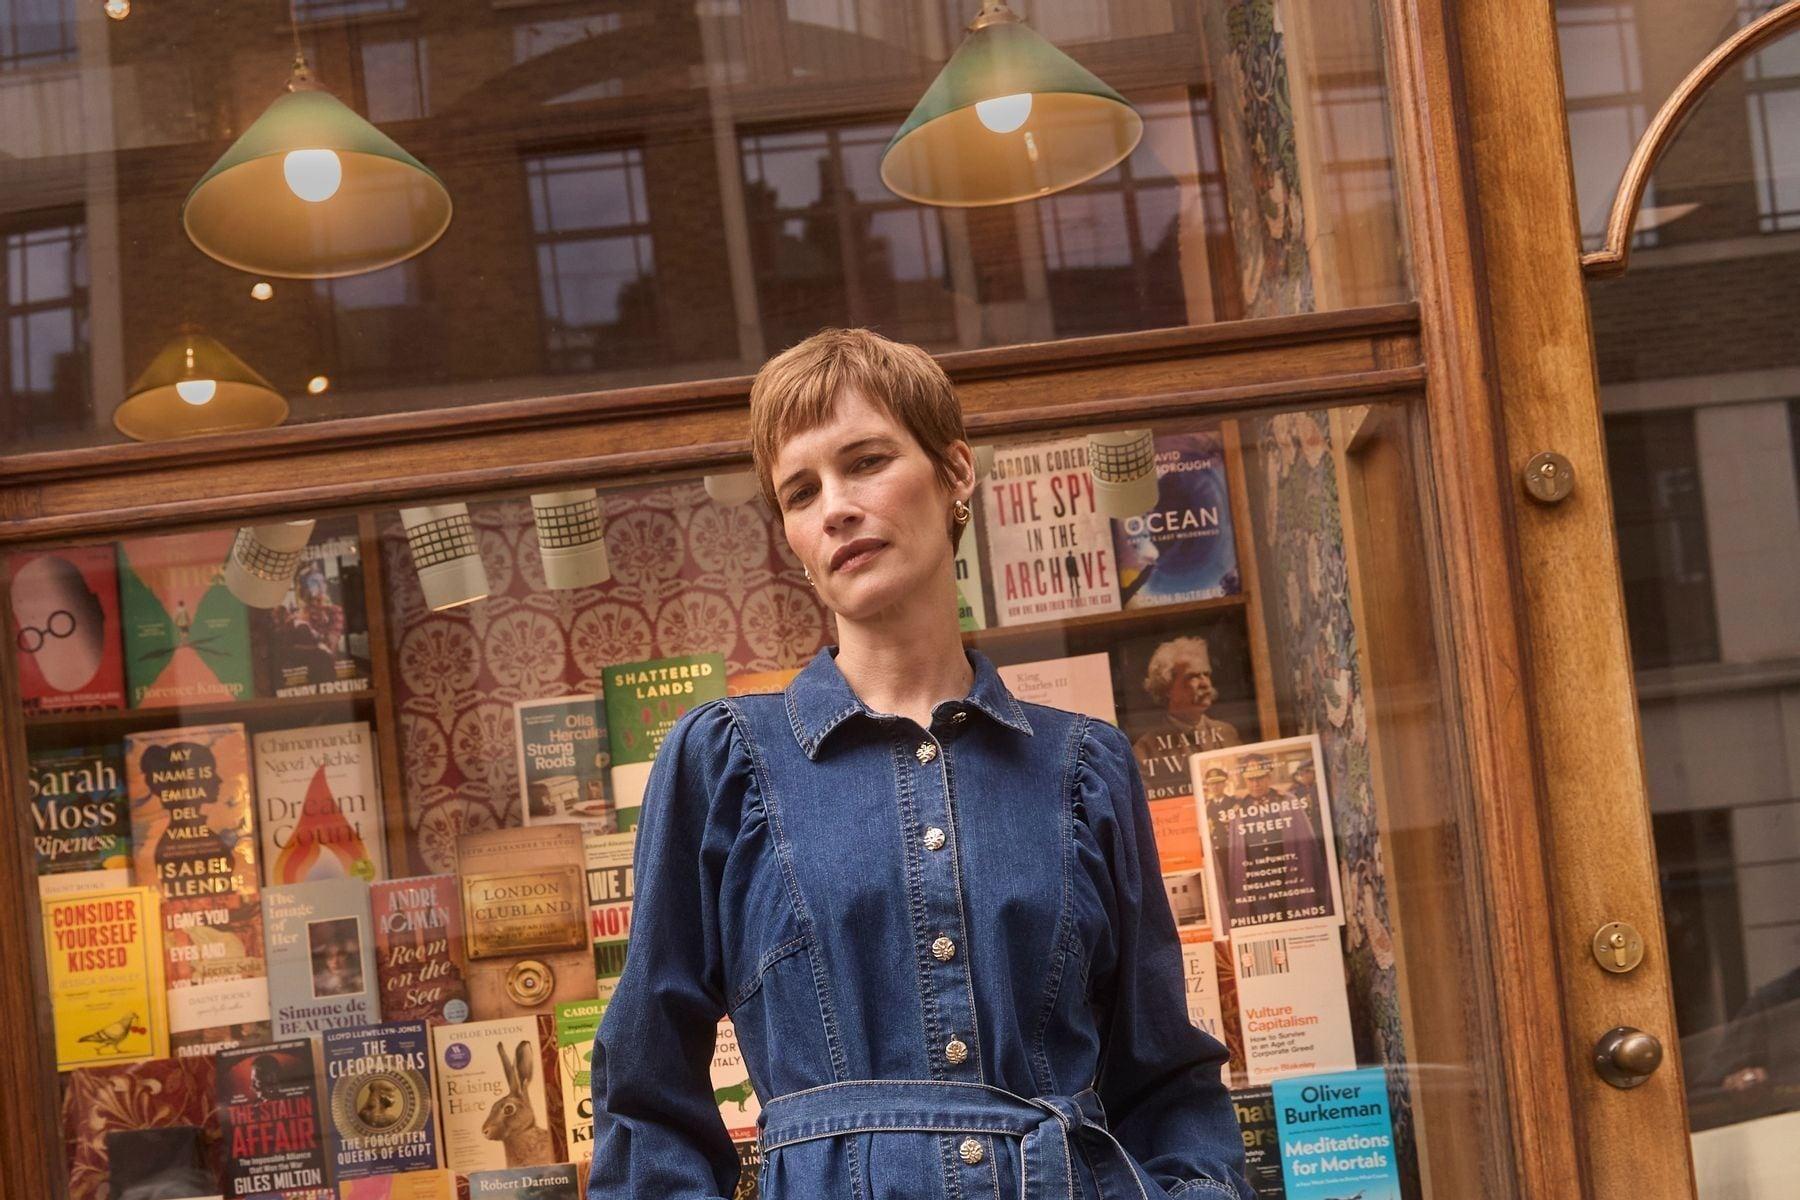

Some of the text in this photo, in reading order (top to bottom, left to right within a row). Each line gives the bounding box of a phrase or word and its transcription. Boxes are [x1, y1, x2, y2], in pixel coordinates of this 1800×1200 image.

[991, 453, 1041, 480] GORDON
[993, 472, 1096, 526] THE SPY
[1124, 506, 1219, 536] OCEAN
[1027, 523, 1078, 552] IN THE
[615, 663, 713, 686] SHATTERED
[636, 681, 694, 699] LANDS
[1156, 727, 1225, 750] MARK
[170, 749, 192, 762] MY
[527, 741, 574, 760] Strong
[535, 755, 576, 770] Roots
[152, 766, 212, 784] NAME IS
[161, 787, 207, 802] EMILIA
[30, 802, 117, 831] Moss
[172, 808, 199, 820] DEL
[267, 791, 367, 822] Dream
[1218, 798, 1309, 822] 38 LONDRES
[167, 825, 209, 841] VALLE
[1238, 817, 1294, 836] STREET
[156, 857, 232, 879] ISABEL
[484, 882, 560, 901] LONDON
[588, 869, 621, 901] WE
[53, 900, 136, 928] CONSIDER
[203, 909, 230, 925] YOU
[380, 907, 450, 934] ACIMAN
[475, 901, 572, 921] CLUBLAND
[592, 906, 631, 938] NOT
[1231, 906, 1326, 928] PHILIPPE SANDS
[54, 923, 137, 951] YOURSELF
[68, 946, 128, 973] KISSED
[170, 944, 199, 963] EYES
[388, 938, 449, 968] Room
[387, 960, 451, 991] on the
[403, 985, 442, 1010] Sea
[279, 998, 366, 1022] Simone de
[1246, 1005, 1293, 1020] Vulture
[280, 1014, 368, 1035] BEAUVOIR
[485, 1026, 523, 1038] DALTON
[1247, 1013, 1319, 1032] Capitalism
[327, 1033, 352, 1042] LLOYD
[362, 1040, 387, 1056] THE
[329, 1051, 426, 1079] CLEOPATRAS
[1301, 1084, 1362, 1104] Oliver
[260, 1096, 312, 1121] STALIN
[1285, 1103, 1382, 1125] Burkeman
[232, 1117, 318, 1159] AFFAIR
[341, 1130, 427, 1151] THE FORGOTTEN
[1285, 1132, 1390, 1158] Meditations
[337, 1143, 431, 1166] QUEENS OF EGYPT
[1292, 1151, 1387, 1177] for Mortals
[234, 1168, 322, 1195] GILES MILTON
[480, 1175, 569, 1192] Robert Darnton
